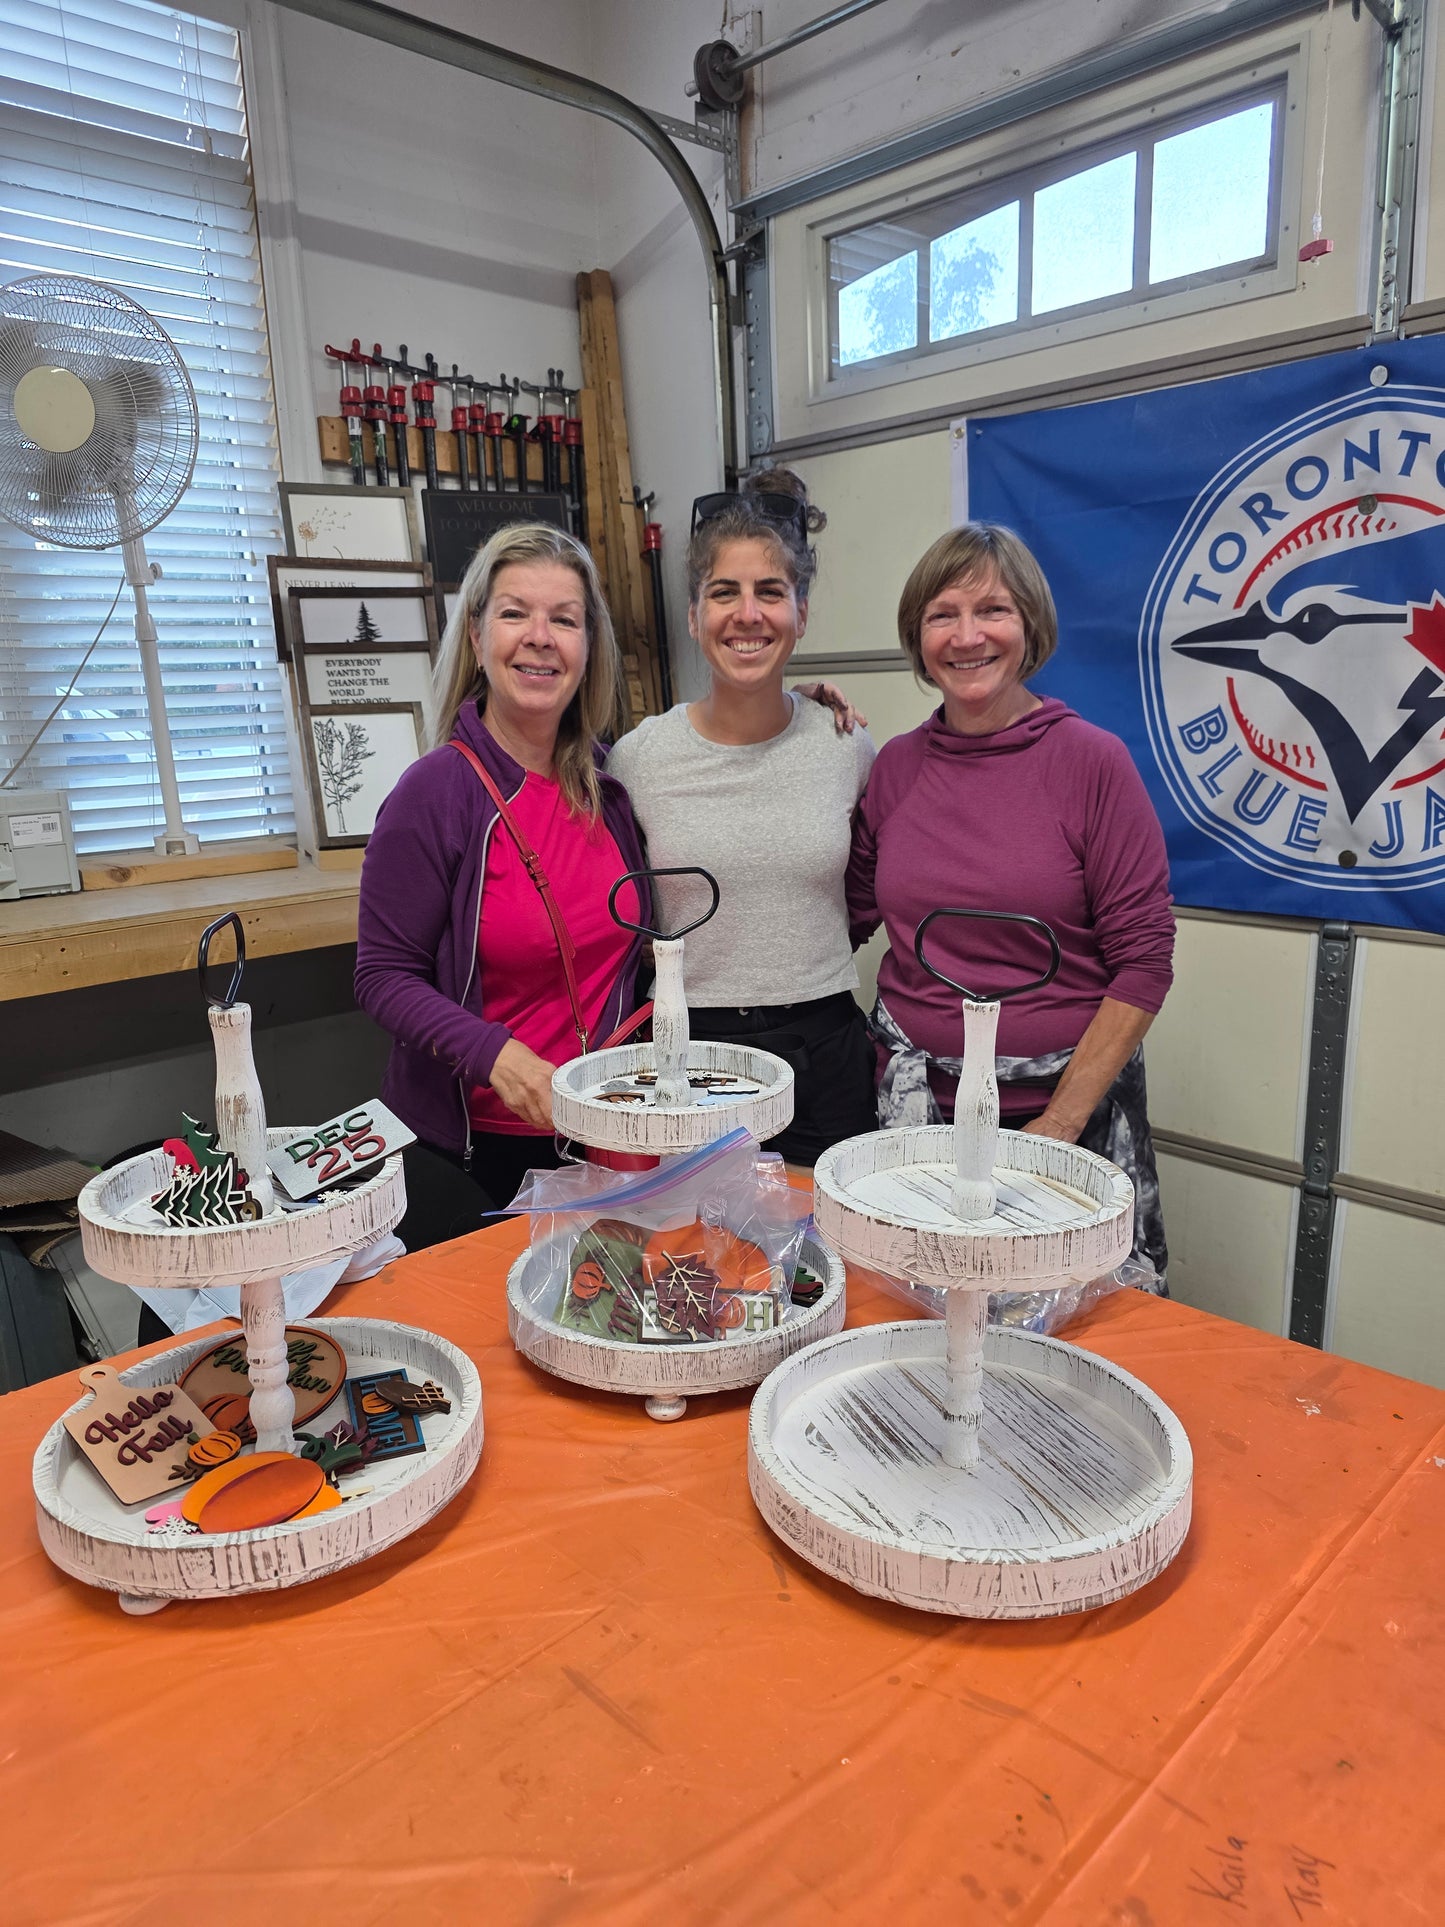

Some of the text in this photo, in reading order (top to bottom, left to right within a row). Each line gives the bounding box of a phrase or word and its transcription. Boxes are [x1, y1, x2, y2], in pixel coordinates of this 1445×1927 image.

[456, 499, 536, 515] WELCOME
[1184, 429, 1445, 608] TORONT
[284, 579, 321, 588] NEVER
[325, 659, 382, 667] EVERYBODY
[326, 668, 376, 677] WANTS TO
[327, 678, 390, 687] CHANGE THE
[329, 688, 365, 697] WORLD
[1179, 705, 1328, 853] BLUE
[285, 1110, 374, 1165] DEC
[307, 1126, 387, 1184] 25
[85, 1390, 174, 1445] Hello
[117, 1415, 193, 1466] Fall
[1187, 1835, 1248, 1910] Kaila
